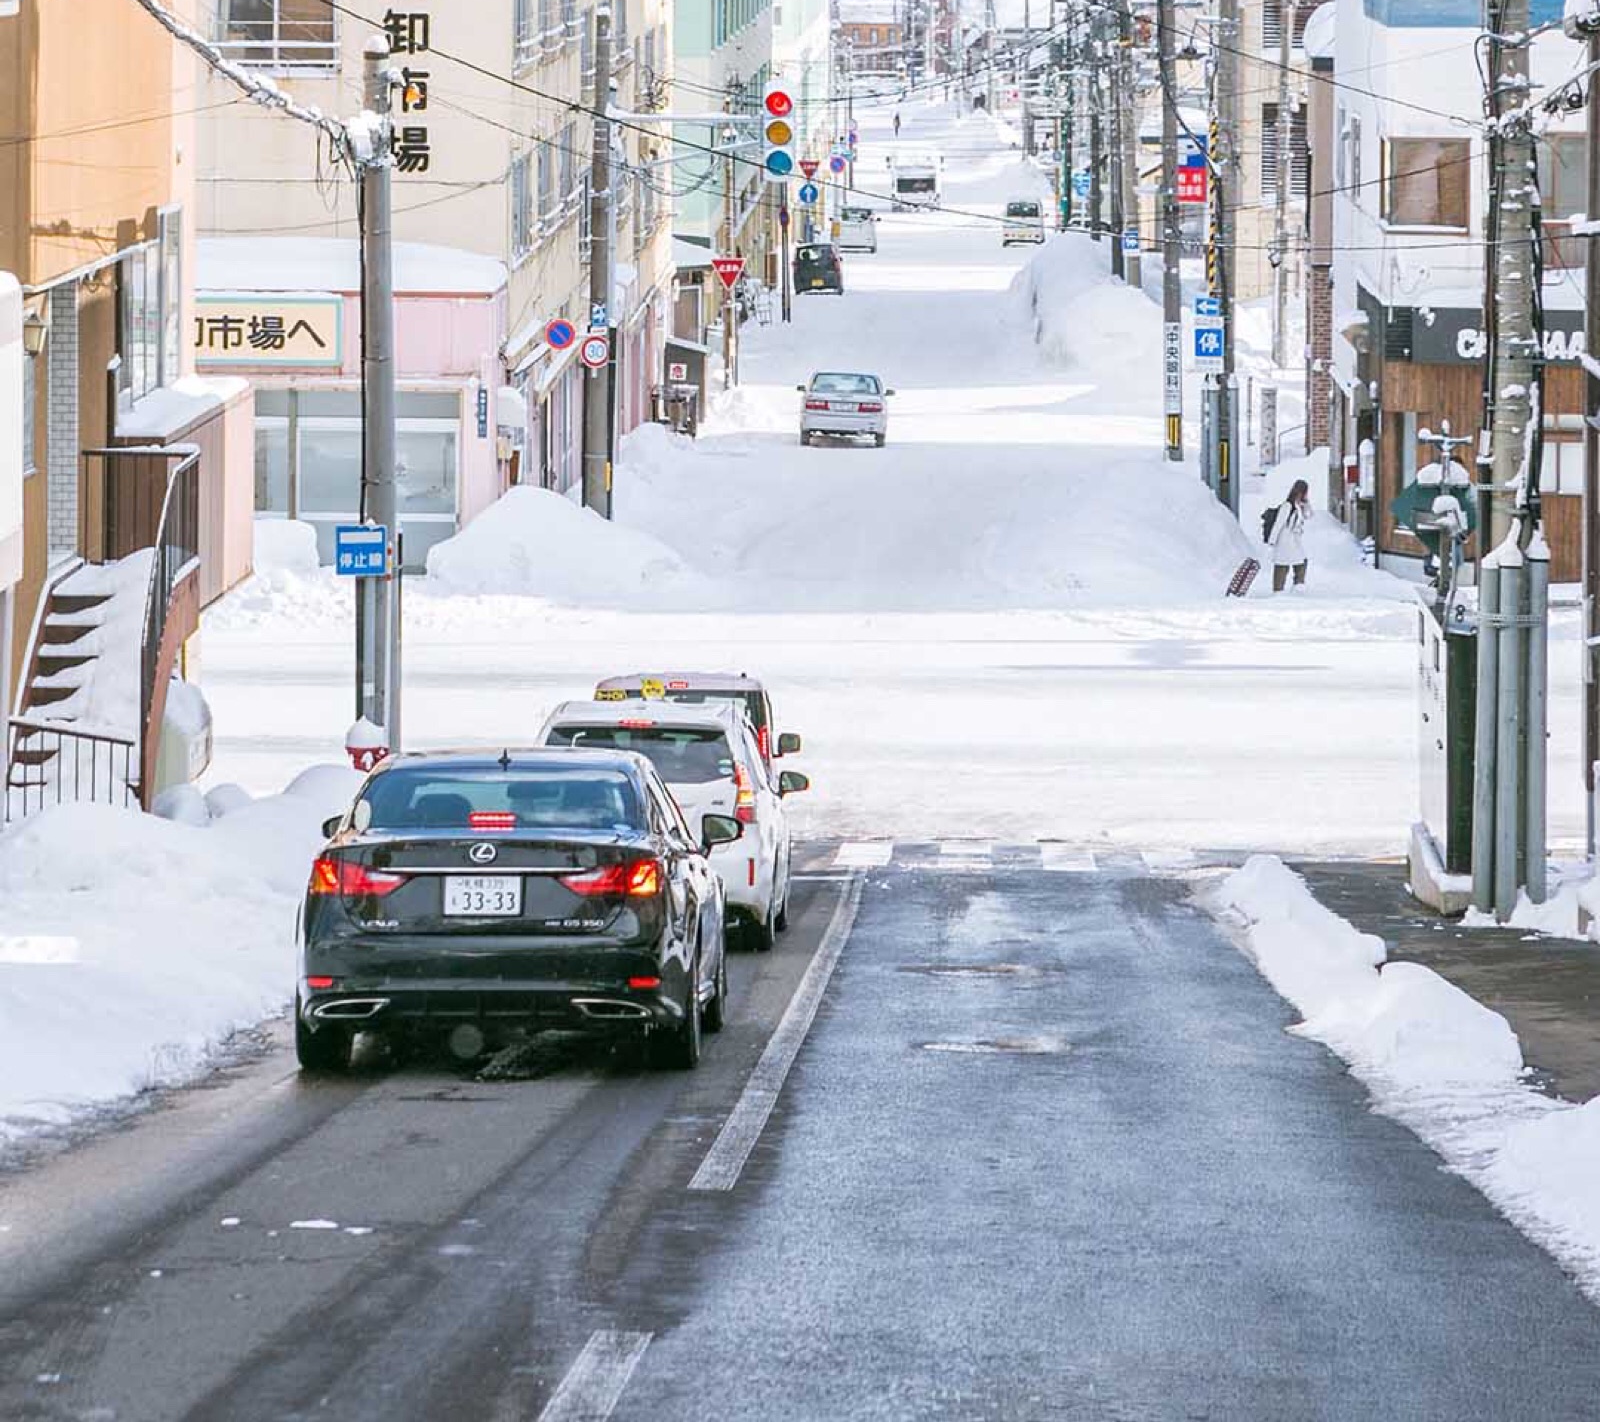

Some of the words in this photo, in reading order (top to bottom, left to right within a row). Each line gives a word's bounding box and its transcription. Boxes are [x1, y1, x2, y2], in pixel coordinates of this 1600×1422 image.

[587, 342, 604, 358] 30
[1199, 332, 1220, 353] 停
[463, 891, 515, 911] 33-33
